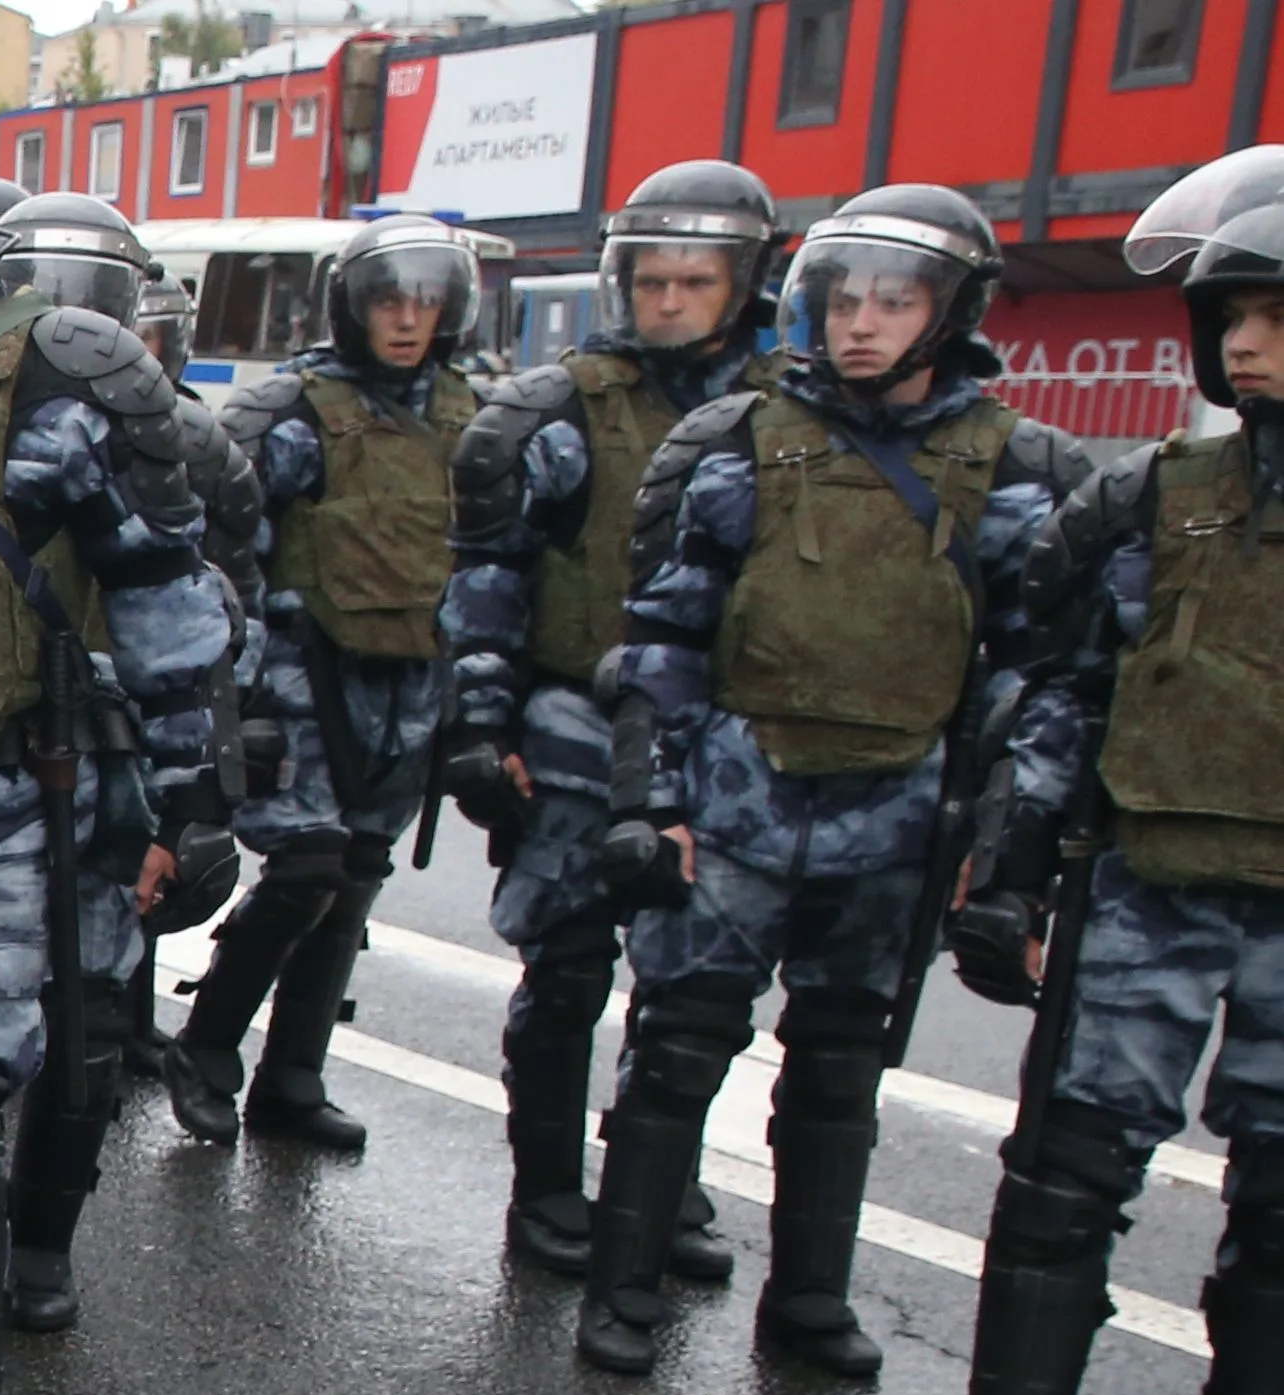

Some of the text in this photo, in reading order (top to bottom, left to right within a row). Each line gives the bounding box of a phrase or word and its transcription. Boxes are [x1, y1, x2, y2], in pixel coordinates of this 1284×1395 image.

[469, 97, 536, 125] ЖИЛЫЕ
[433, 133, 568, 165] АПАРТАМЕНТЫ
[1066, 338, 1140, 388] ОТ
